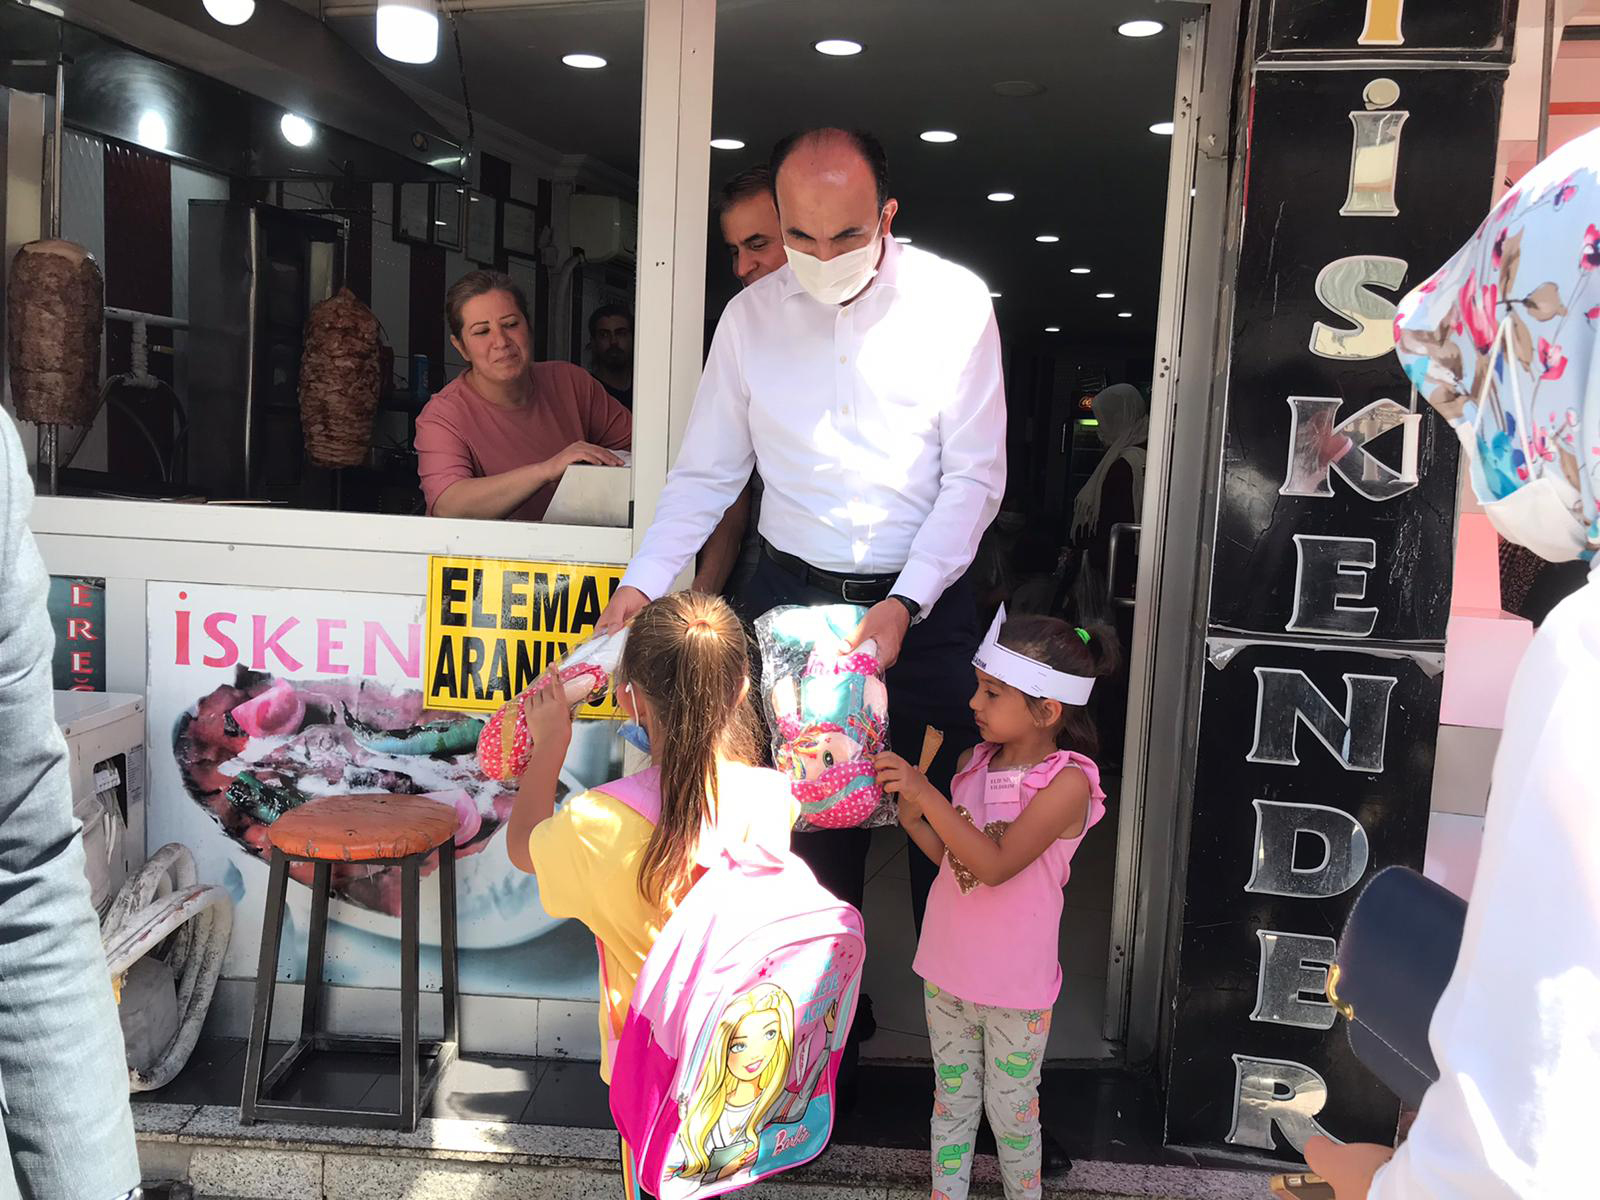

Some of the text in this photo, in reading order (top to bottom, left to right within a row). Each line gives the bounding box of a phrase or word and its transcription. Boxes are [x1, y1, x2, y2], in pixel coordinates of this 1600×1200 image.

[66, 583, 97, 692] ERE
[174, 591, 423, 679] İSKEN
[440, 566, 622, 634] ELEMA
[431, 634, 617, 707] ARANI
